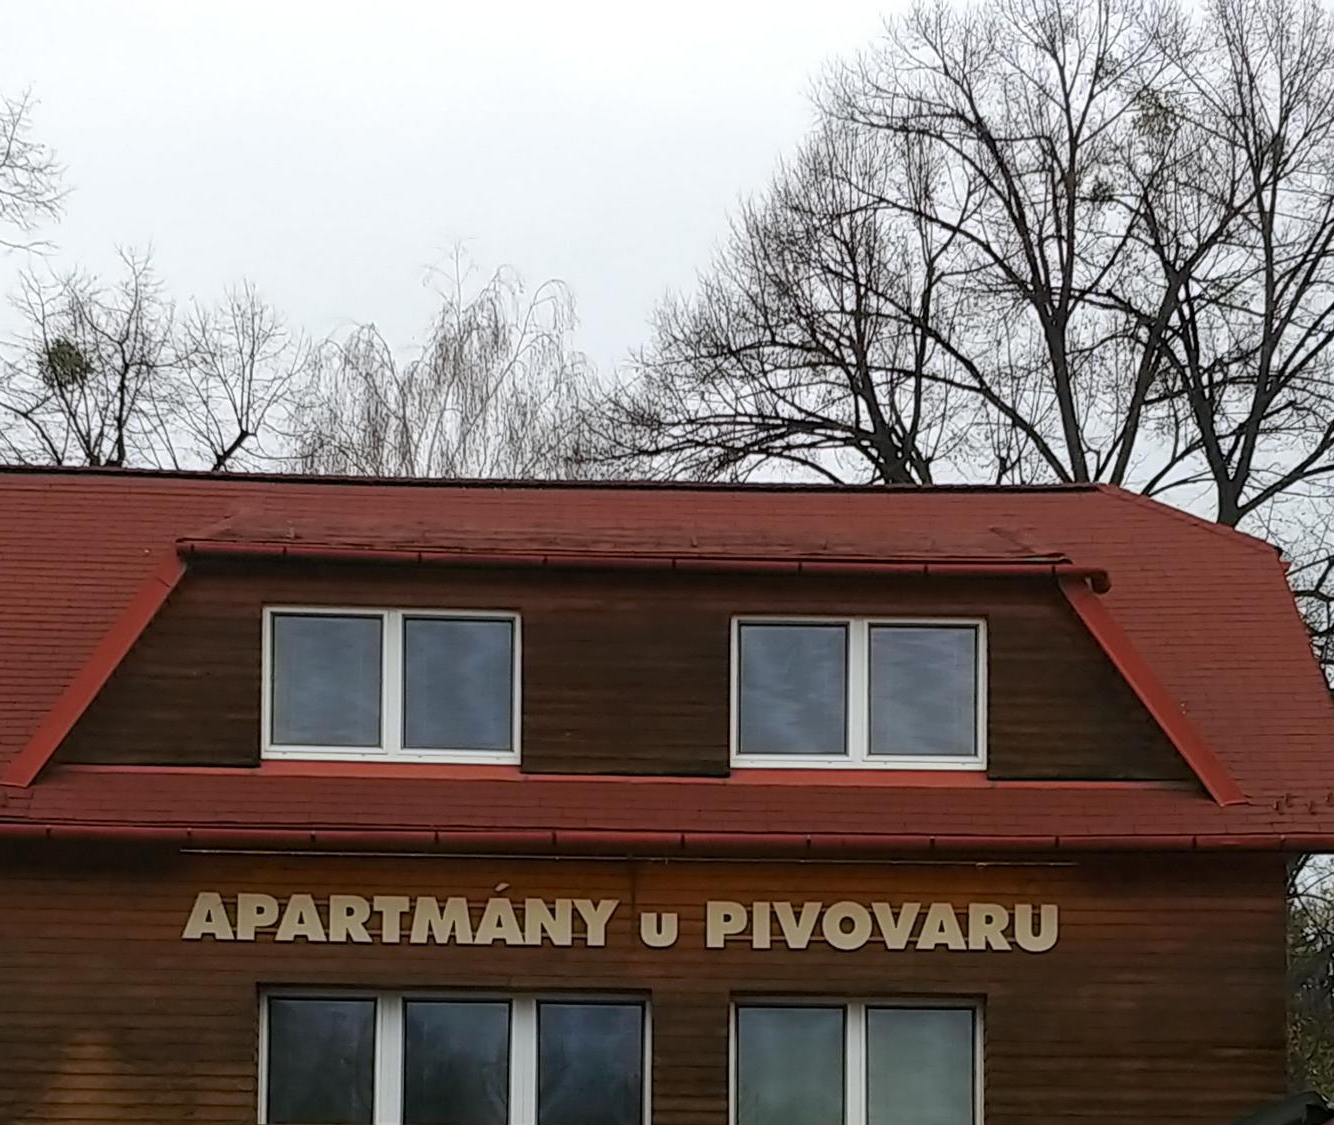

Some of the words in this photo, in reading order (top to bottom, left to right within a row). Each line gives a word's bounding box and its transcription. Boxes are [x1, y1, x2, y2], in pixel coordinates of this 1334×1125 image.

[181, 883, 619, 947] APARTMÁNY
[640, 911, 679, 948] u
[705, 900, 1059, 953] PIVOVARU
